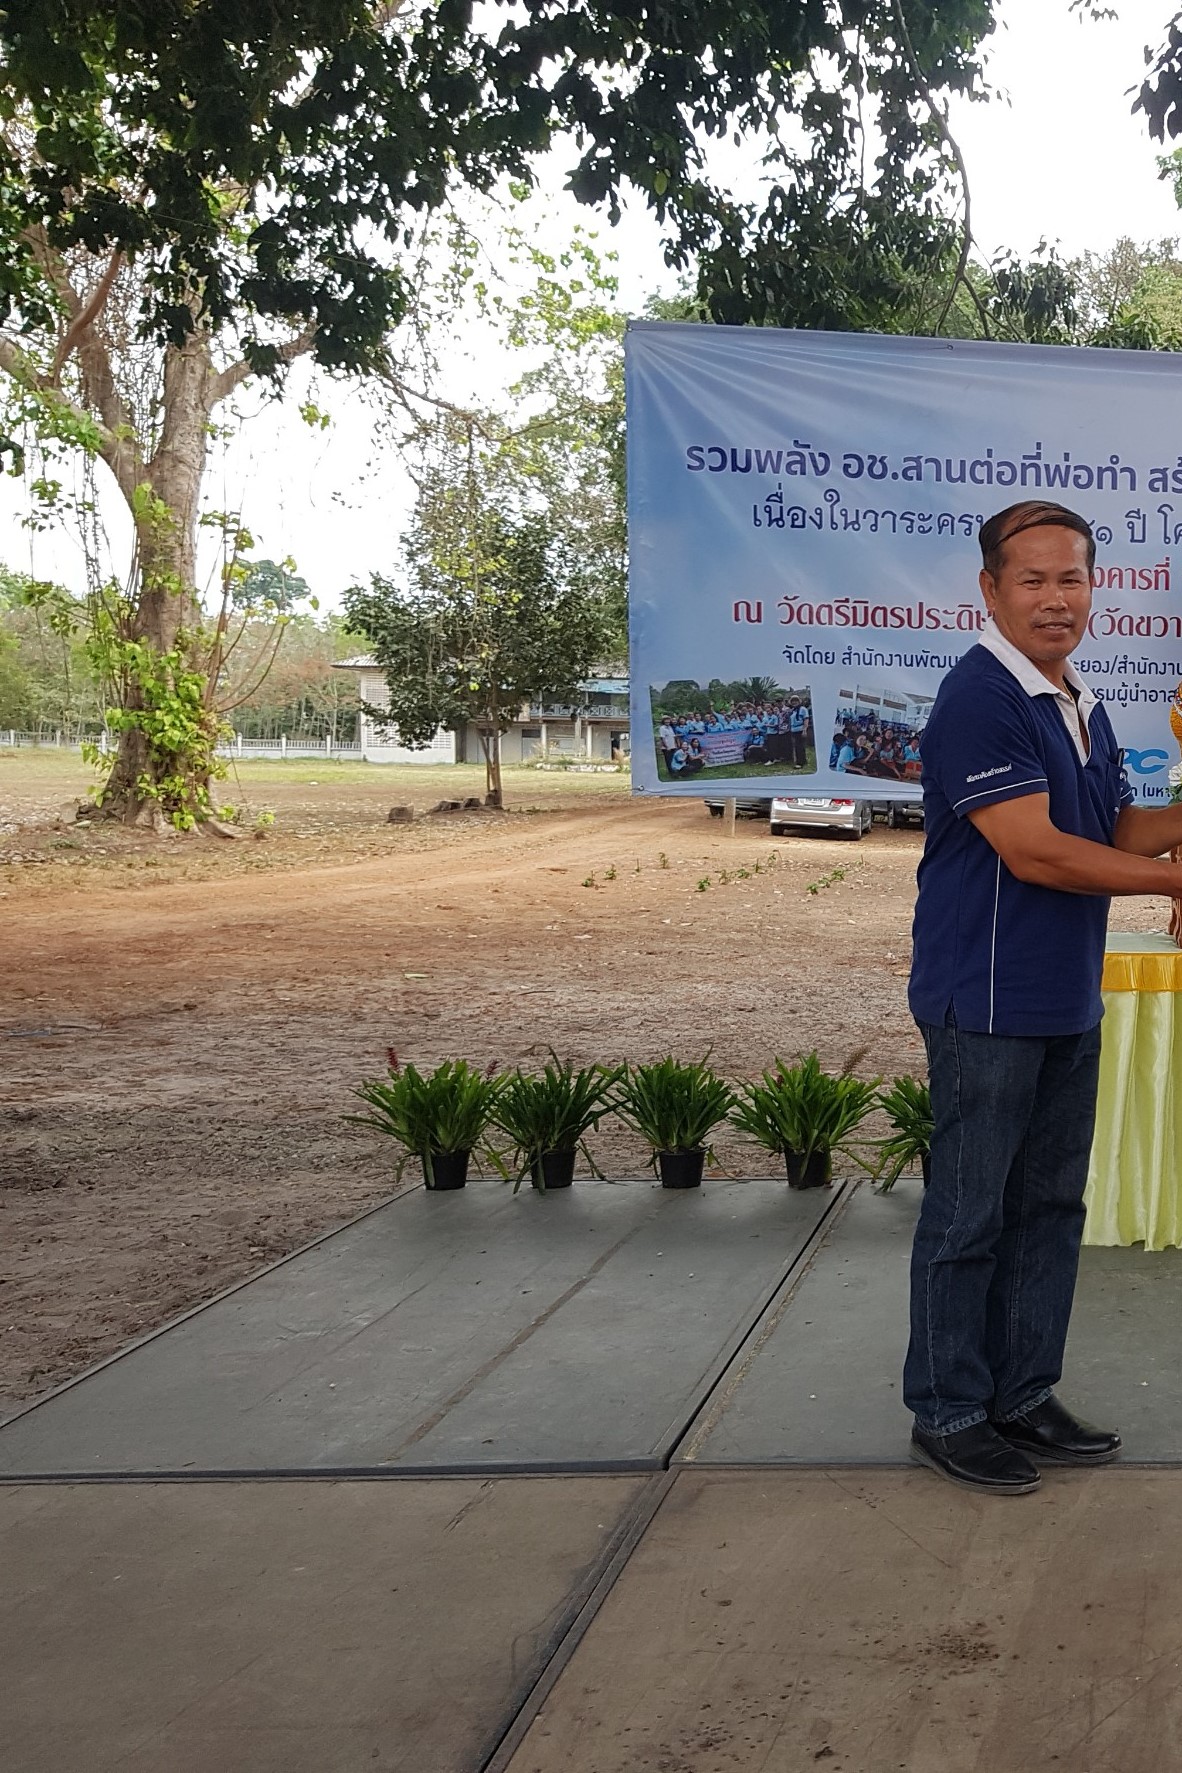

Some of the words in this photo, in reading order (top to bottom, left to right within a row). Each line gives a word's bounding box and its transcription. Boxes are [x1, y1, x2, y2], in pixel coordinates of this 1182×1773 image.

[686, 440, 831, 477] รวมพลัง
[842, 442, 1137, 491] อช.สานต่อที่พ่อทำ
[1125, 508, 1147, 543] ปี
[733, 600, 763, 624] ณ
[782, 645, 835, 665] จัดโดย
